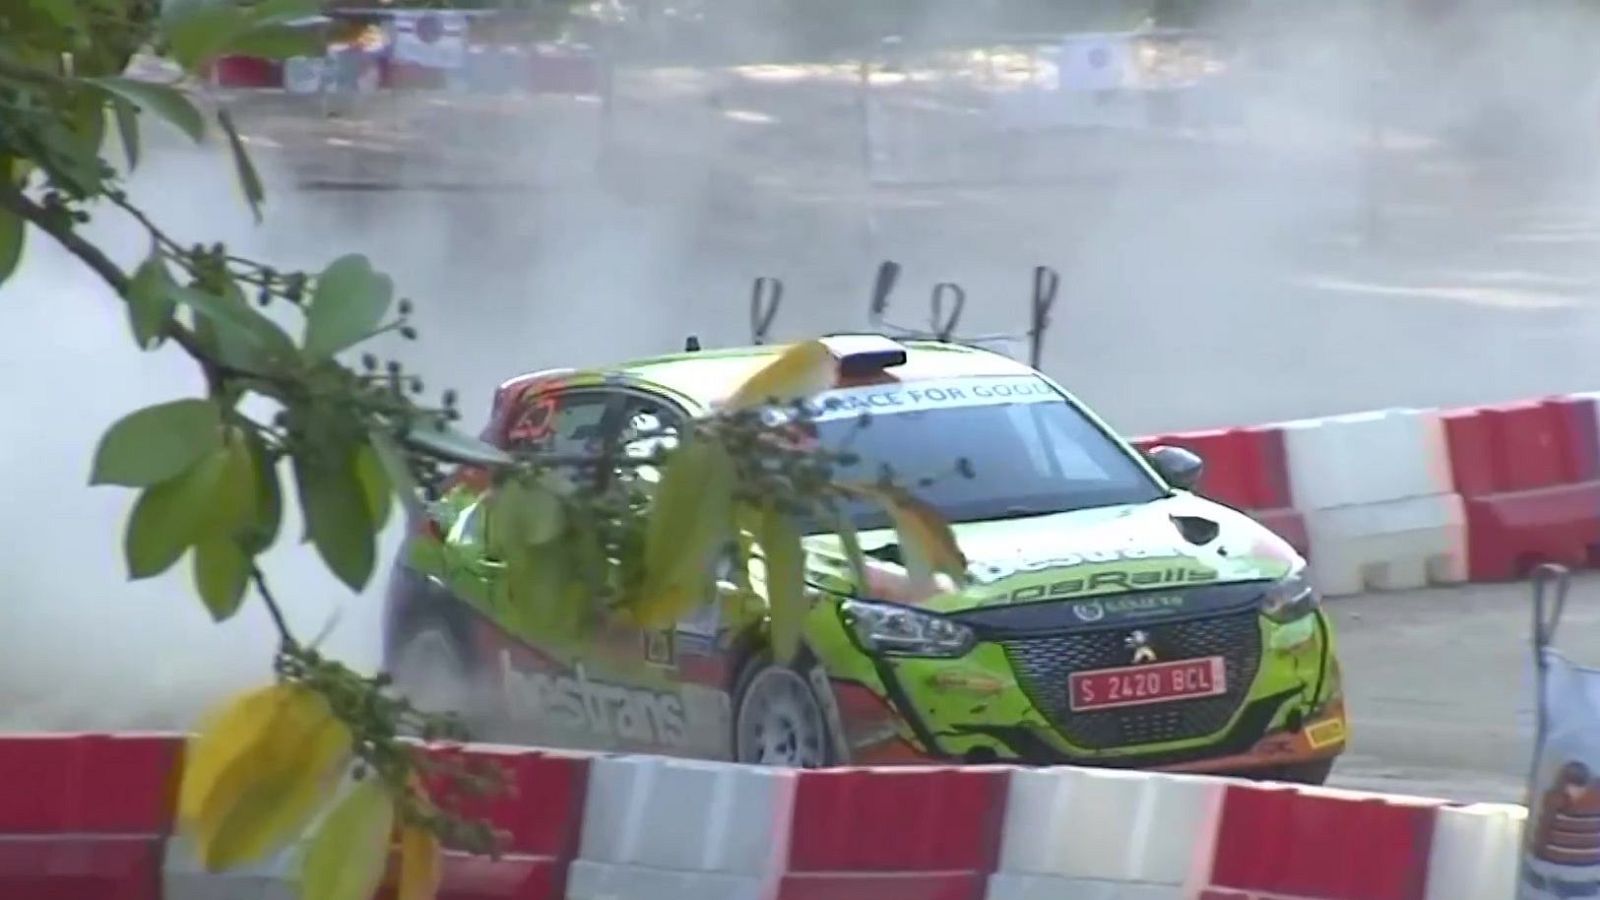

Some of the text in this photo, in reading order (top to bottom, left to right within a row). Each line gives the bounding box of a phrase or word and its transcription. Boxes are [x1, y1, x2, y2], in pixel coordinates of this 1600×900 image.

[907, 386, 967, 404] FOR
[1080, 667, 1211, 703] S 2420 BCL
